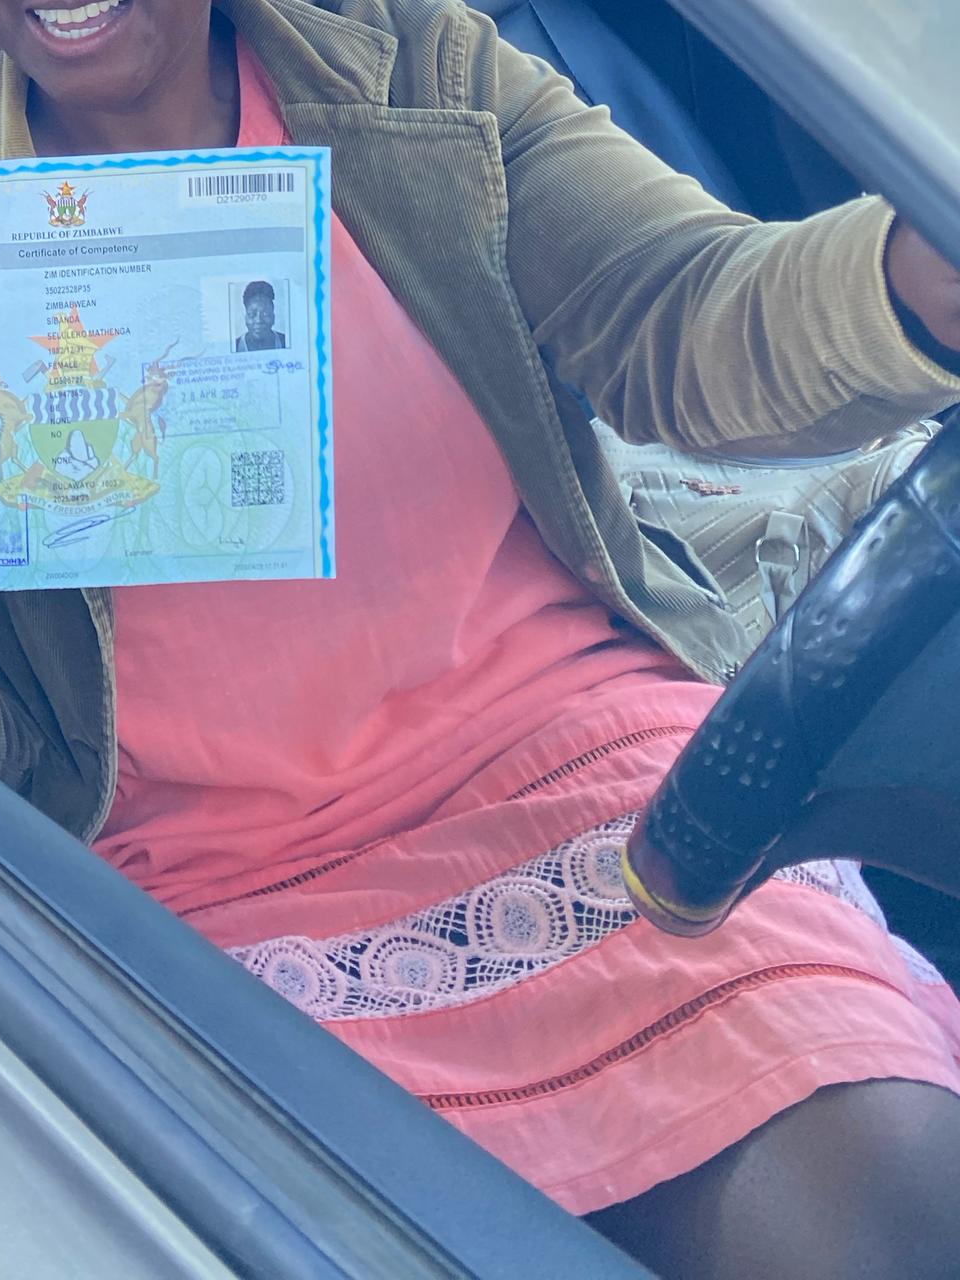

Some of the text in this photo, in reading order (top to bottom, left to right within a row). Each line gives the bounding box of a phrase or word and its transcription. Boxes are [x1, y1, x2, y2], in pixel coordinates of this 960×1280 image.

[11, 226, 123, 241] REPUBLIC OF ZIMBABWE
[18, 244, 139, 258] Certificate of Competency
[44, 264, 152, 279] ZIM IDENTIFICATION NUMBER
[45, 300, 97, 310] ZIMBABWEAN
[46, 315, 80, 325] SIBANDA
[50, 417, 71, 425] NONE
[52, 456, 72, 464] NONE
